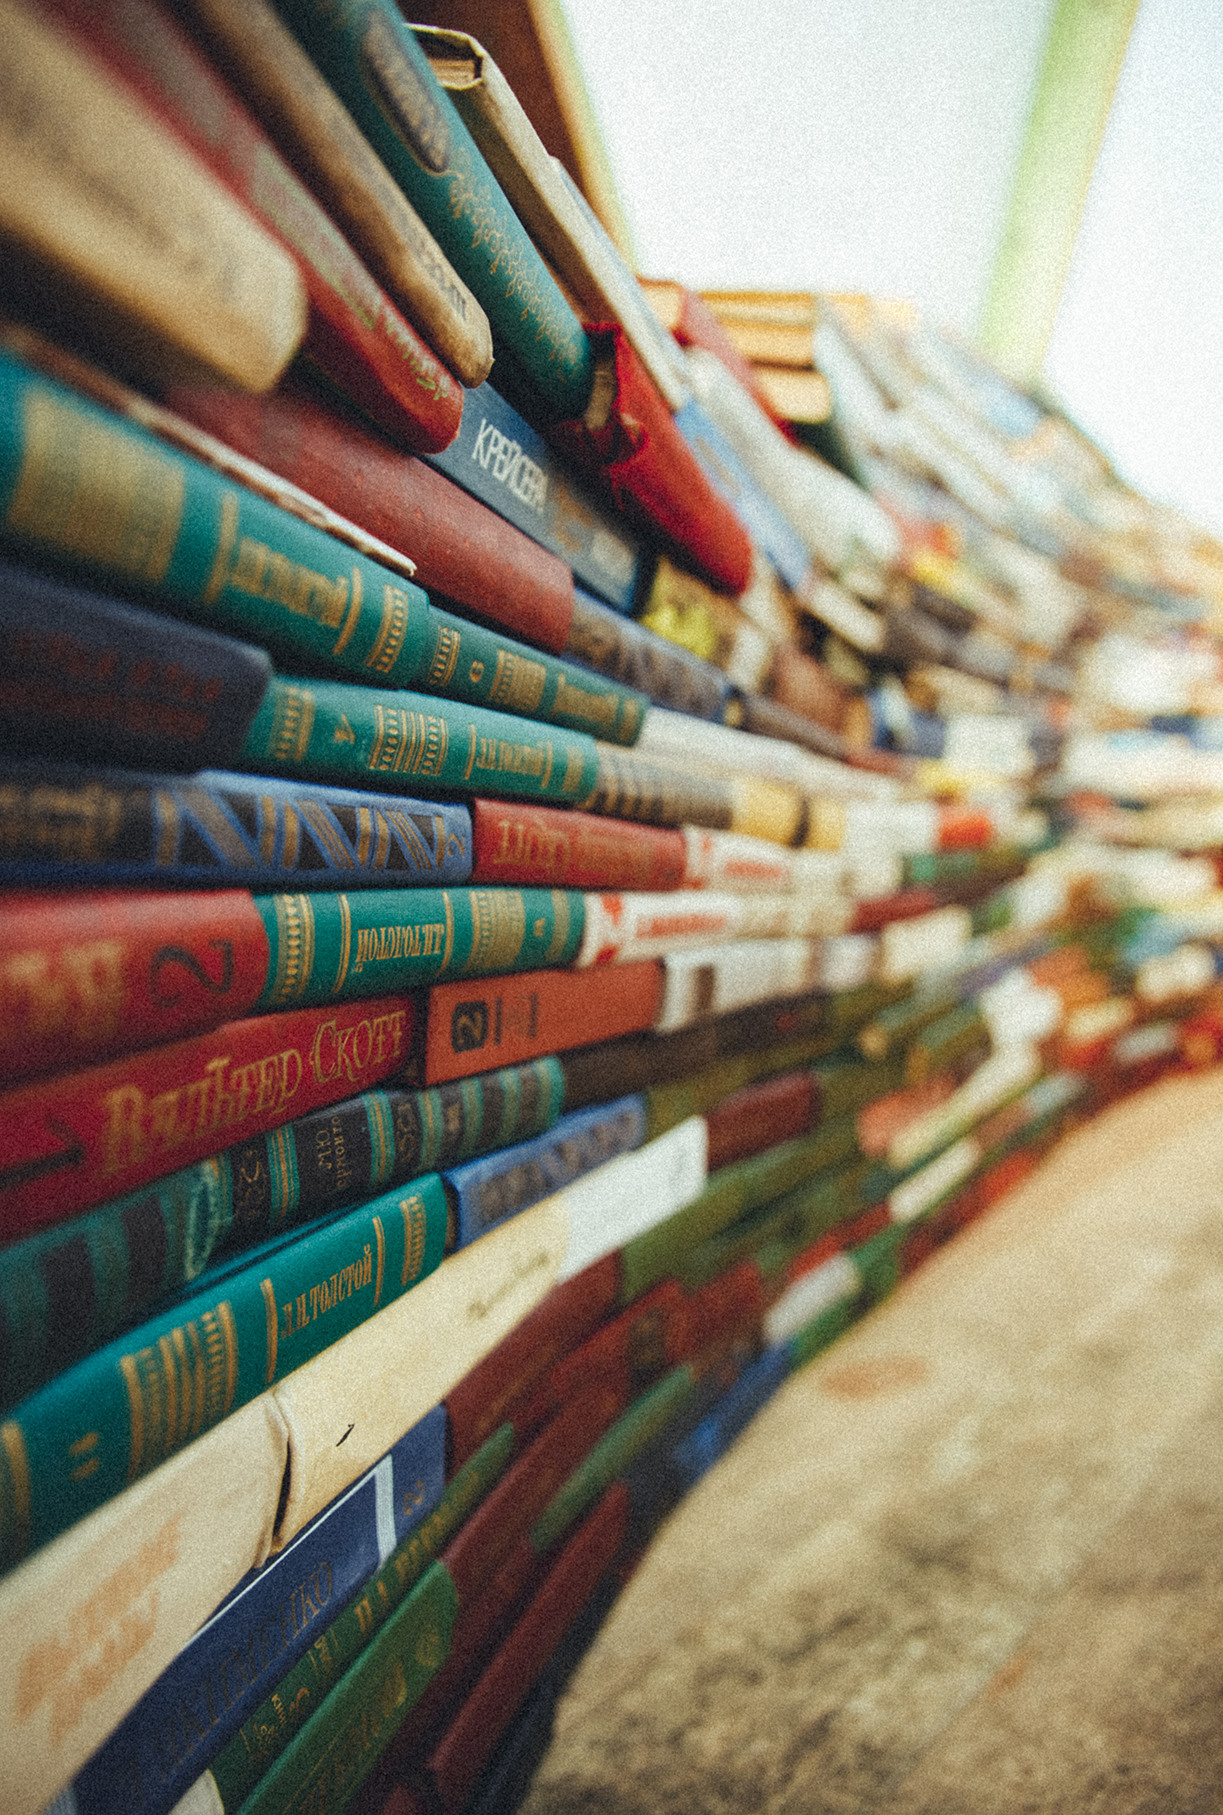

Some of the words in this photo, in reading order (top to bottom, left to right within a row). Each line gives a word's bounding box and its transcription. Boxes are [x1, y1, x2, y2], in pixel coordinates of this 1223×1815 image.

[150, 940, 234, 1010] 2
[457, 1011, 483, 1045] 2
[403, 1480, 426, 1515] 2
